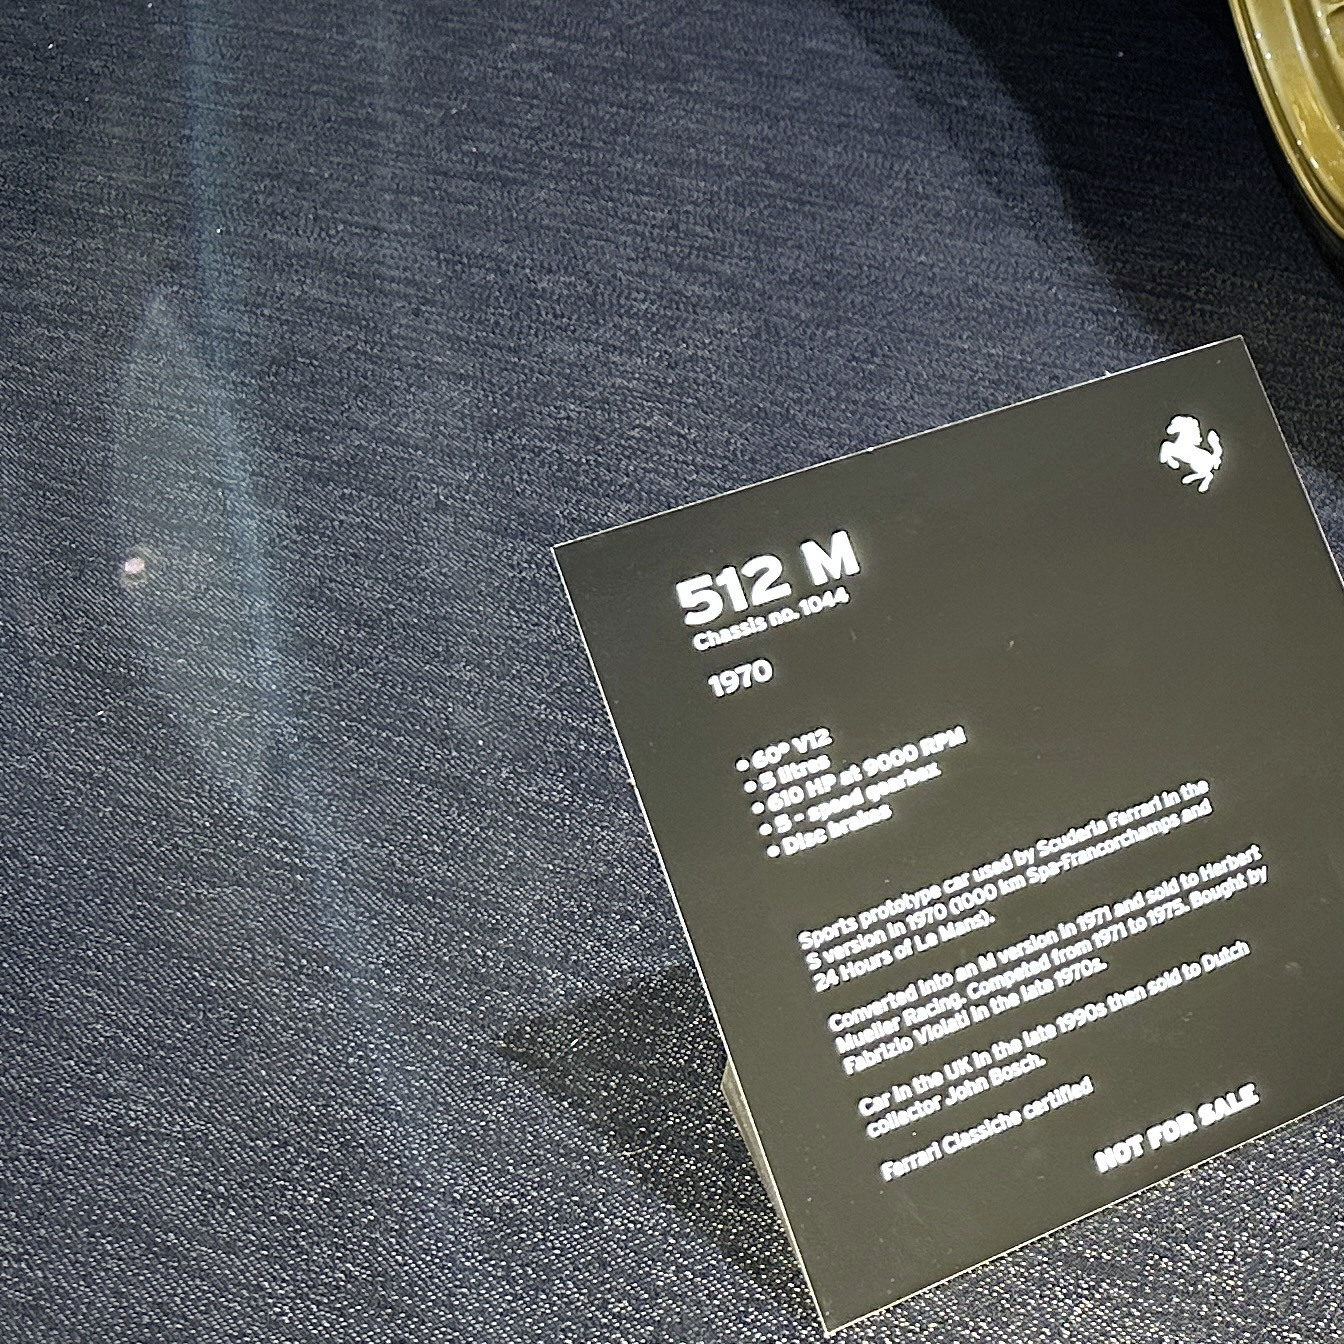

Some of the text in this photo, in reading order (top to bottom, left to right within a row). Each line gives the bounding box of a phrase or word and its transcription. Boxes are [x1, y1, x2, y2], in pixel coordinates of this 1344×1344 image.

[675, 530, 860, 626] 512 M
[692, 586, 850, 651] Chassis no. 1044
[707, 659, 773, 697] 1970
[757, 770, 777, 792] 5
[765, 726, 967, 812] 610 HP at 9000 RPM
[791, 727, 833, 754] V12
[773, 813, 793, 834] 5
[805, 786, 865, 823] speed
[780, 803, 893, 856] Disc brakes
[797, 780, 1210, 951] Sports prototype car used by Scuderia Ferrari in the
[805, 951, 822, 971] S
[821, 929, 888, 964] version
[885, 921, 908, 940] in
[905, 902, 948, 931] 1970
[948, 883, 998, 916] (1000
[997, 874, 1027, 896] km
[1180, 797, 1213, 824] and
[812, 909, 996, 993] 24 Hours of Le Mans).
[827, 844, 1263, 1033] Converted into an M version in 1971 and sold to Herbert
[834, 865, 1267, 1054] Mueller Racing. Competed from 1971 to 1975. Bought by
[842, 1036, 914, 1076] Fabrizio
[969, 1005, 991, 1023] in
[989, 992, 1021, 1015] the
[1019, 978, 1055, 1003] late
[1053, 957, 1108, 988] 1970s.
[857, 940, 1251, 1117] Car in the UK in the late 1990s then sold to Dutch
[866, 1052, 1047, 1139] collector John Bosch.
[879, 1075, 1094, 1182] Ferrari Classiche certified
[1094, 1083, 1260, 1174] NOT FOR SALE
